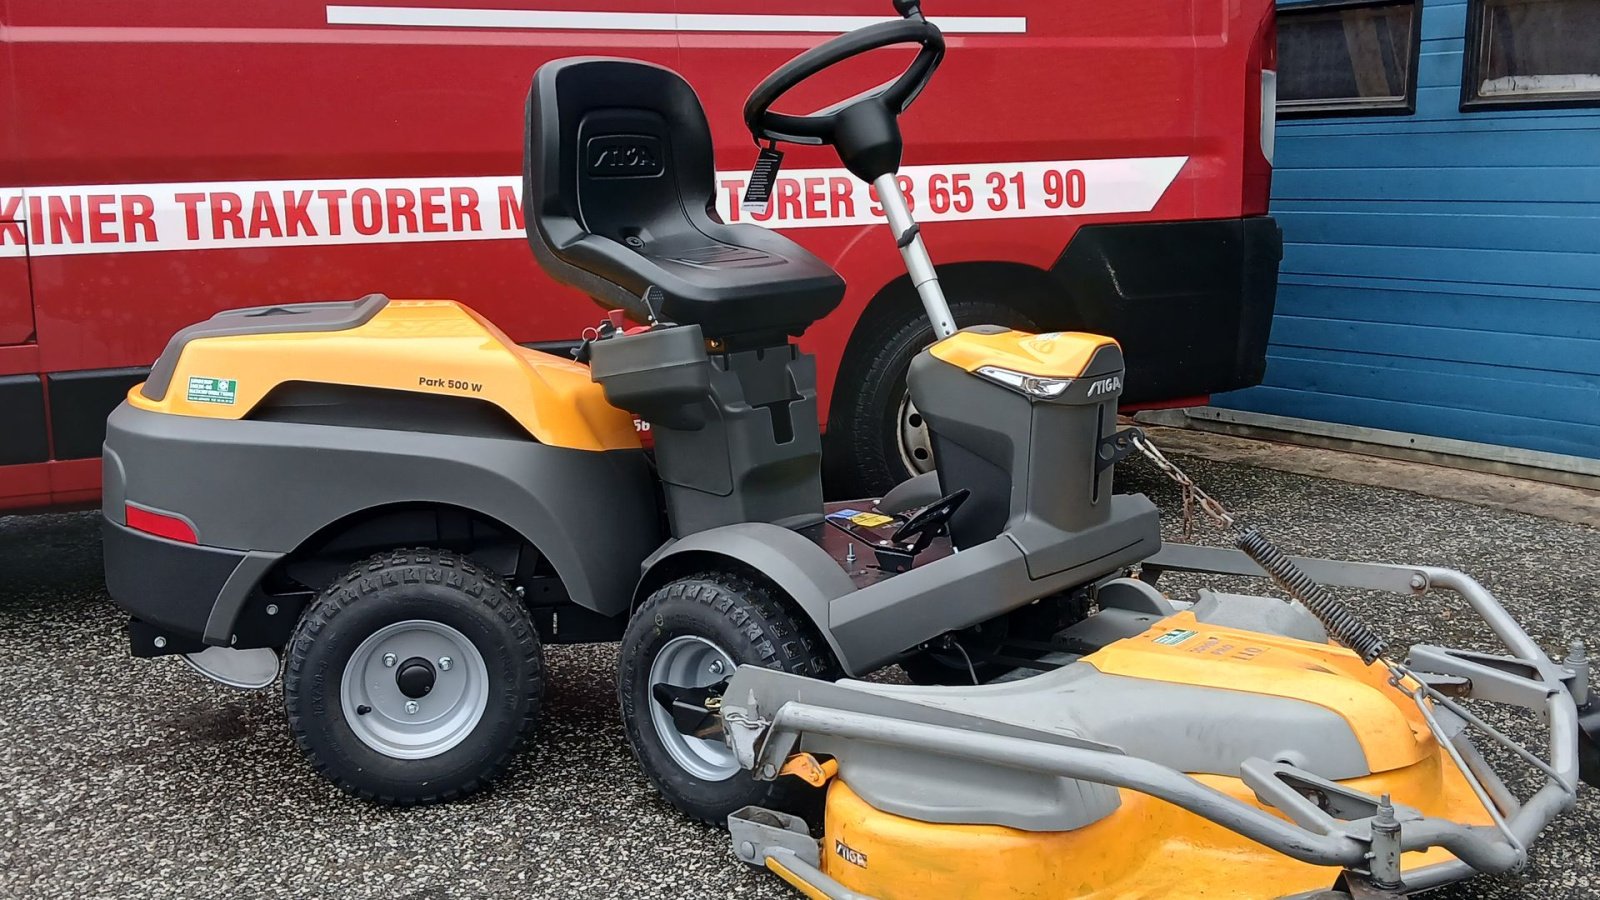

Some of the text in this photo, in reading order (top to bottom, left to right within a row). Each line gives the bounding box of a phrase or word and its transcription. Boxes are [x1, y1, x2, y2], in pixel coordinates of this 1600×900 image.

[594, 147, 657, 167] STIGA
[0, 194, 159, 246] KINER
[174, 186, 483, 241] TRAKTORER
[928, 173, 975, 214] 65
[985, 171, 1027, 211] 31
[1043, 168, 1087, 209] 90
[418, 376, 483, 393] Park 500 W
[1087, 377, 1121, 397] STIGA
